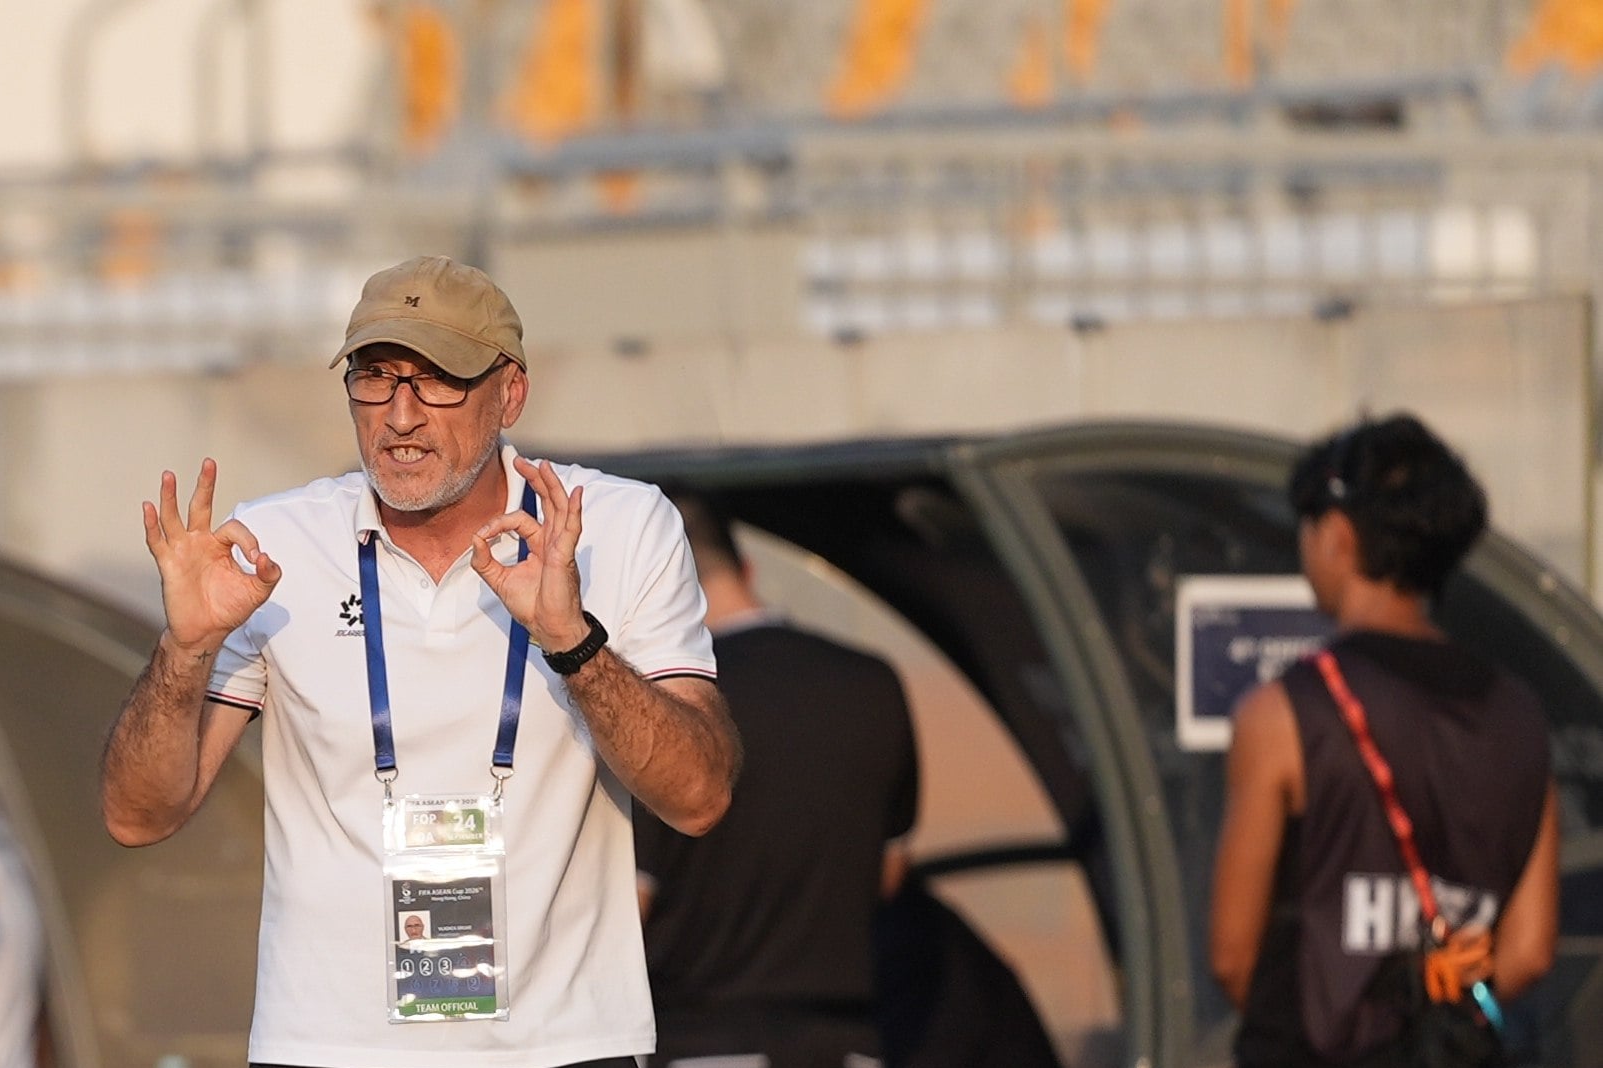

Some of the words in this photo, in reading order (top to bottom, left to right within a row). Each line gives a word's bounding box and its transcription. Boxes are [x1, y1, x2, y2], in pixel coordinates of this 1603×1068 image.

[453, 814, 477, 832] 24
[418, 888, 431, 896] FIFA
[432, 888, 452, 896] ASEAN
[452, 887, 465, 895] Cup
[415, 1003, 439, 1013] TEAM
[440, 1002, 479, 1012] OFFICIAL
